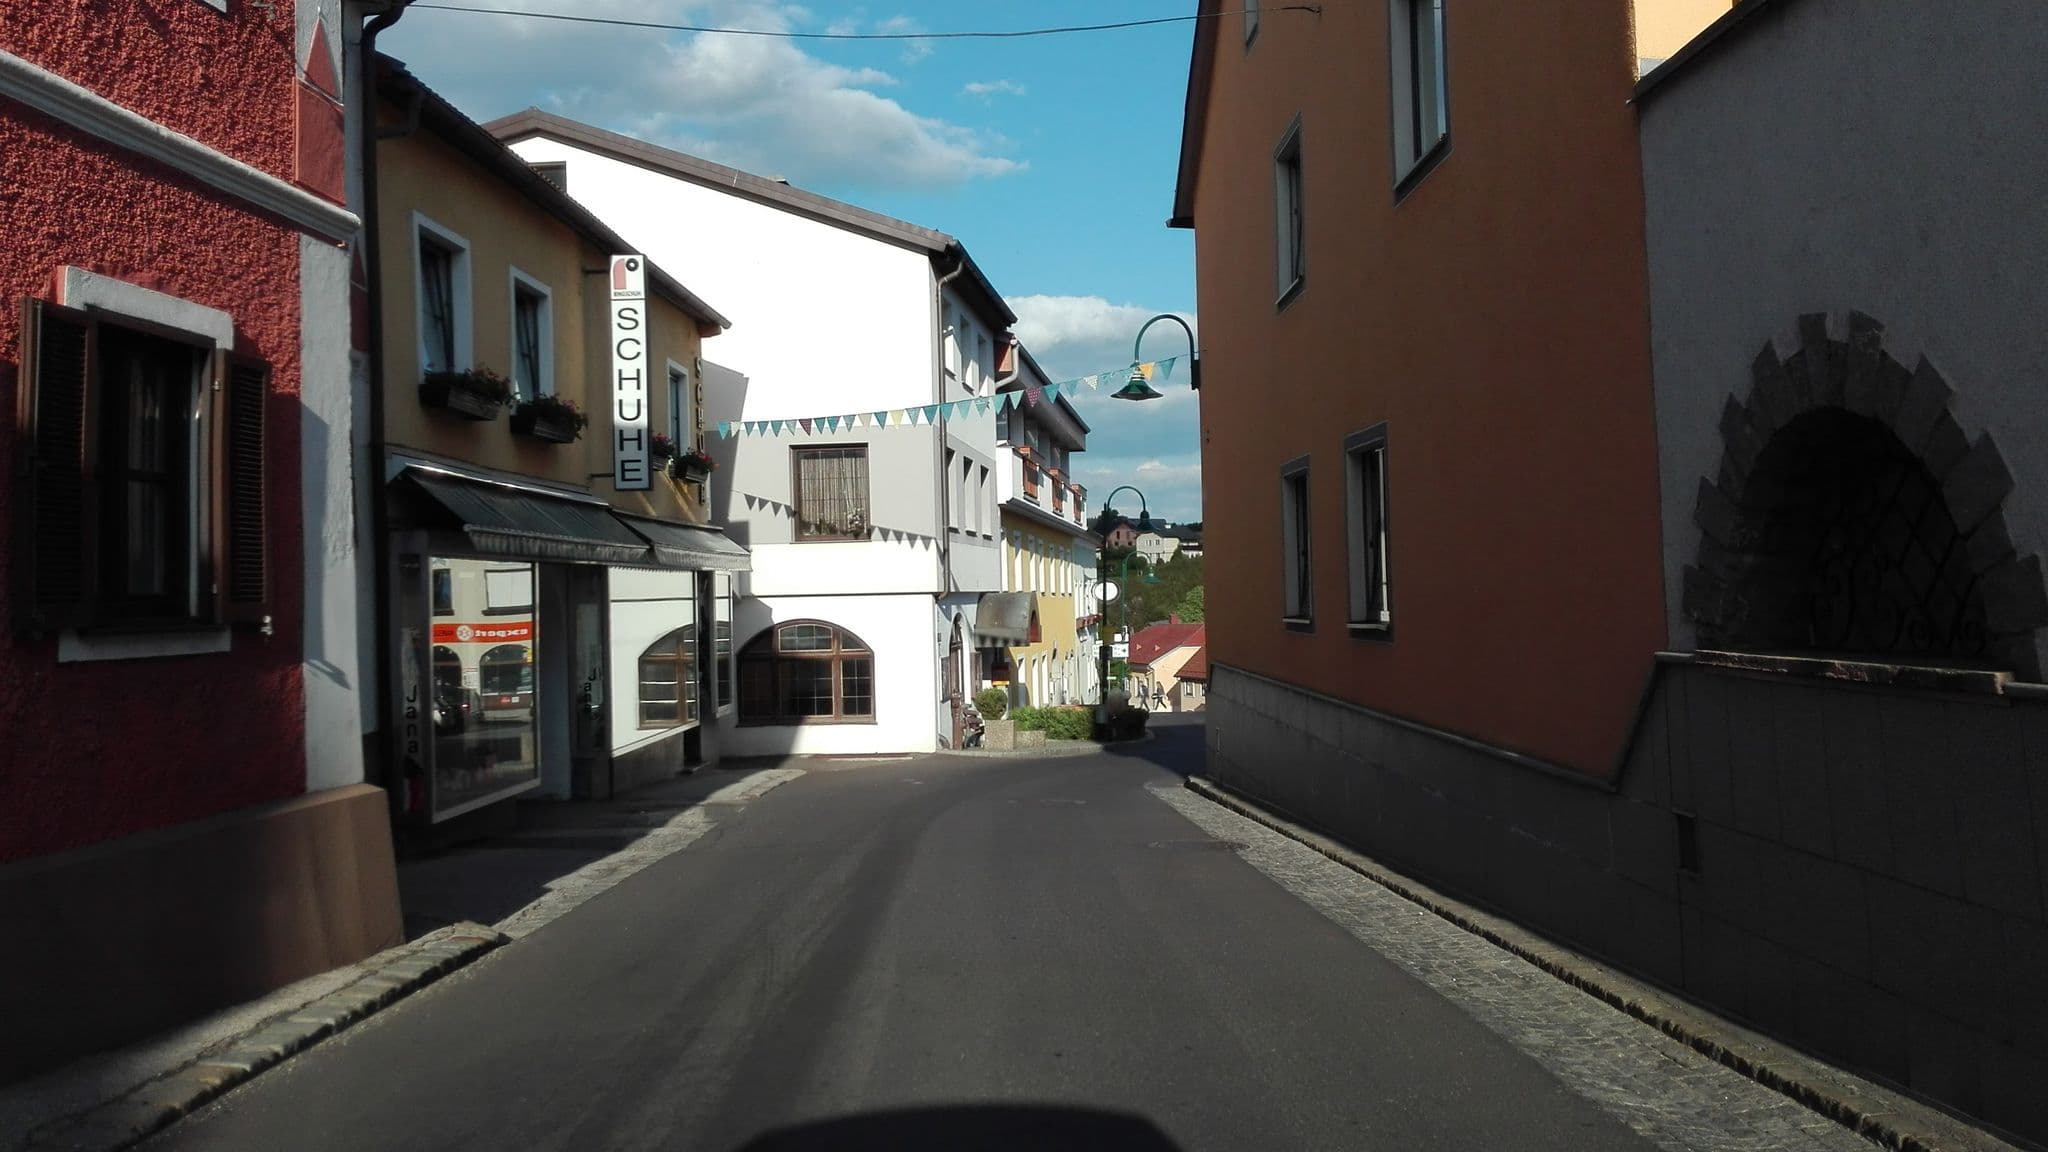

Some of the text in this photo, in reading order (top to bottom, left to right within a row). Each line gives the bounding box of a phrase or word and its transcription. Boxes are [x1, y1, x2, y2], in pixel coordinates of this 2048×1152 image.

[616, 307, 643, 482] SCHUHE
[695, 356, 705, 505] SCHUE
[406, 684, 418, 754] Jana
